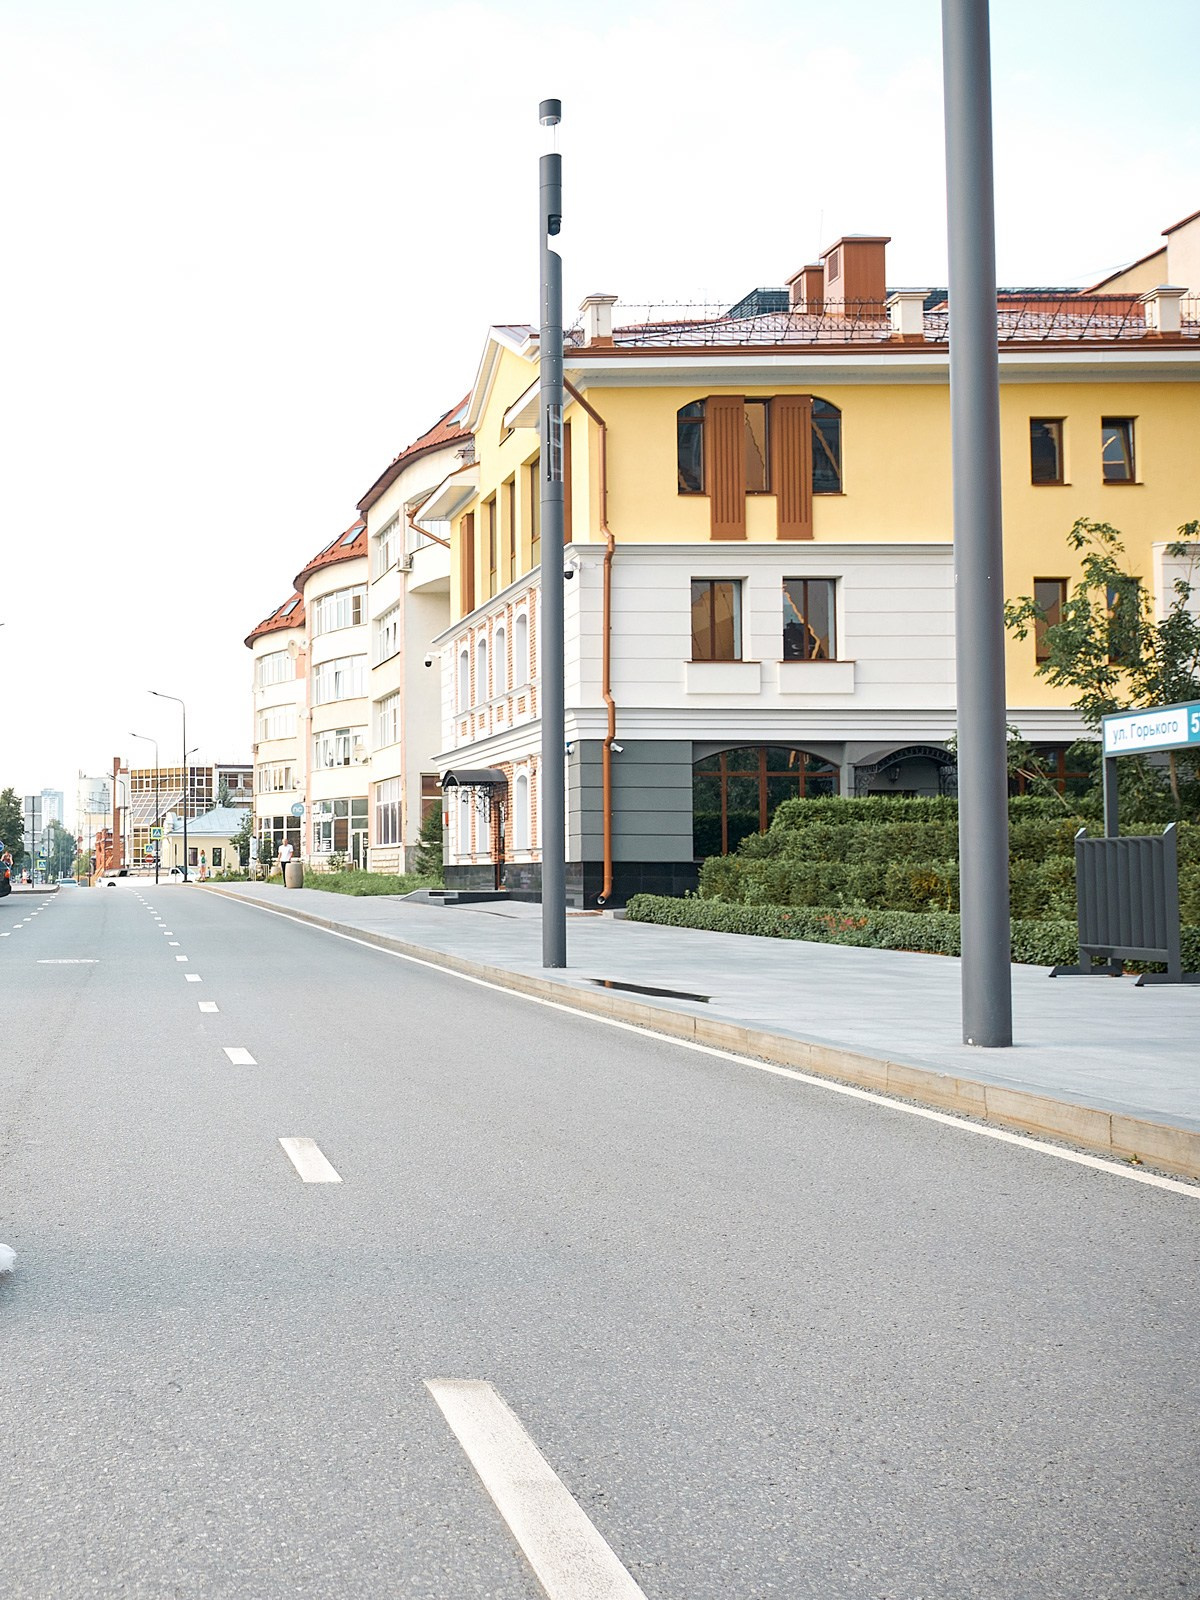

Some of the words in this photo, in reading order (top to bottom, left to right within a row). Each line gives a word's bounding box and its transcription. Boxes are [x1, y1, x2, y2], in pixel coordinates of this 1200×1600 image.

[1113, 728, 1128, 744] ул.
[1130, 720, 1178, 740] Горького
[1191, 711, 1200, 734] 5
